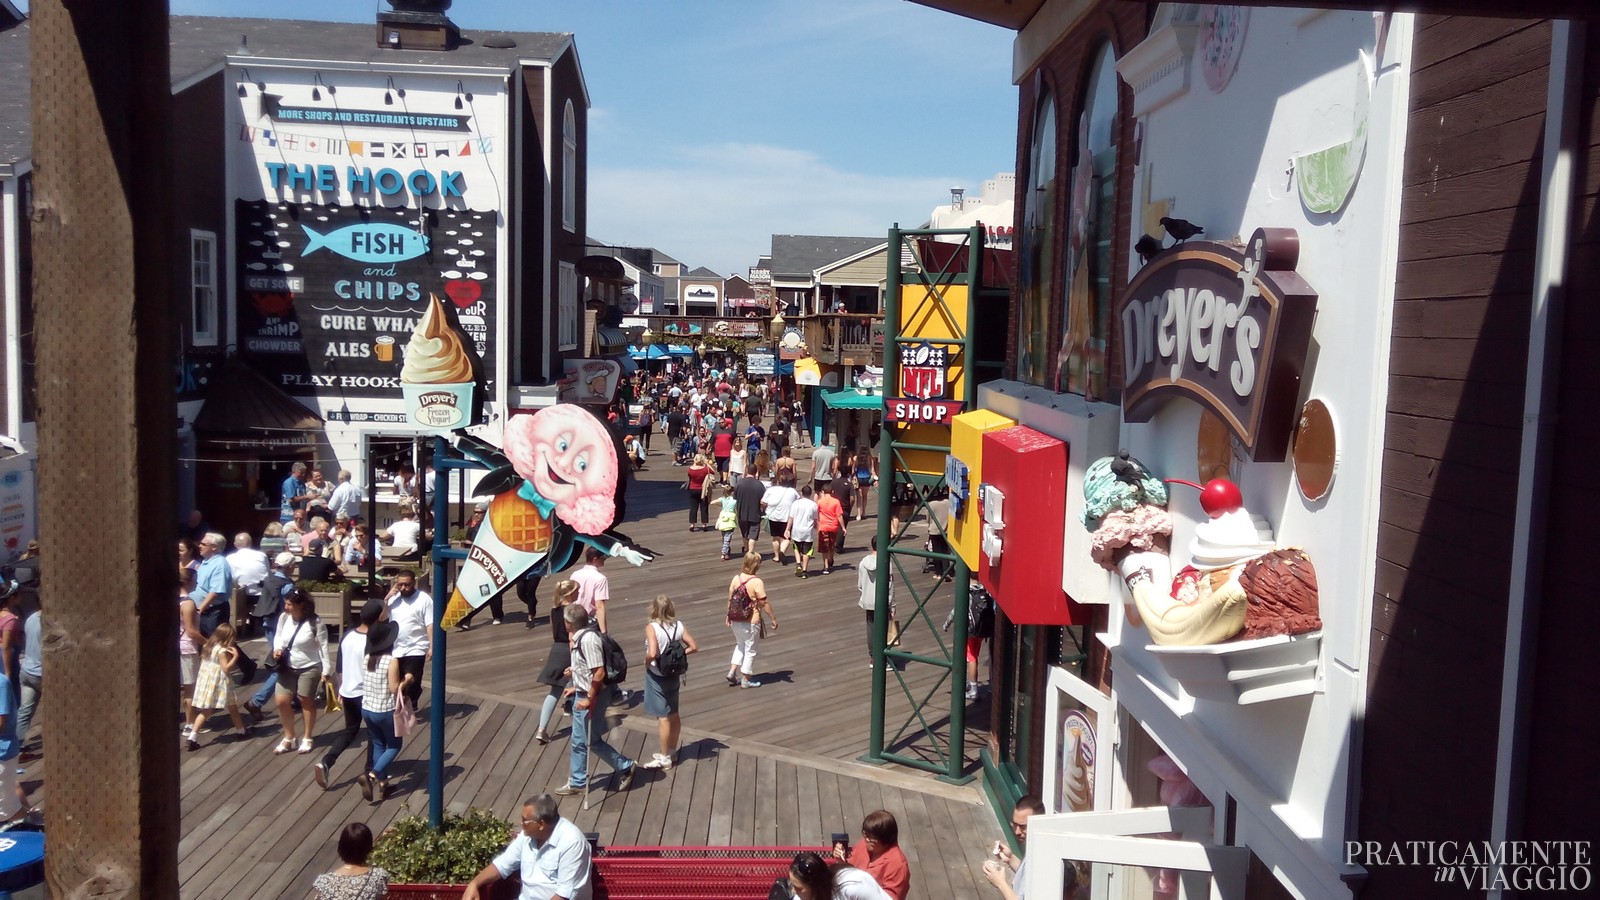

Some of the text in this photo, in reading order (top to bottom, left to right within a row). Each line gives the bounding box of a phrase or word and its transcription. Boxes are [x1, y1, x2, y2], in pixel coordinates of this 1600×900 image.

[278, 109, 458, 128] MORE SHOPS AND RESTAURANTS UPSTAIRS
[264, 162, 463, 197] THE HOOK
[351, 232, 404, 254] FISH
[363, 264, 396, 276] and
[249, 278, 300, 290] GET SOME
[334, 280, 421, 300] CHIPS
[266, 317, 280, 325] AND
[320, 314, 366, 330] CURE
[1121, 256, 1261, 396] Dreyer's
[258, 322, 300, 336] SHRIMP
[248, 340, 300, 351] CHOWDER
[325, 342, 370, 358] ALES
[281, 374, 337, 387] PLAY
[903, 366, 943, 399] NFL
[420, 392, 456, 405] Dreyer's
[350, 413, 368, 421] WRAP
[374, 414, 398, 422] CHICKEN
[428, 406, 450, 416] Frozen
[896, 404, 947, 420] SHOP
[428, 416, 450, 424] Yogurt
[472, 548, 506, 584] Dreyer's
